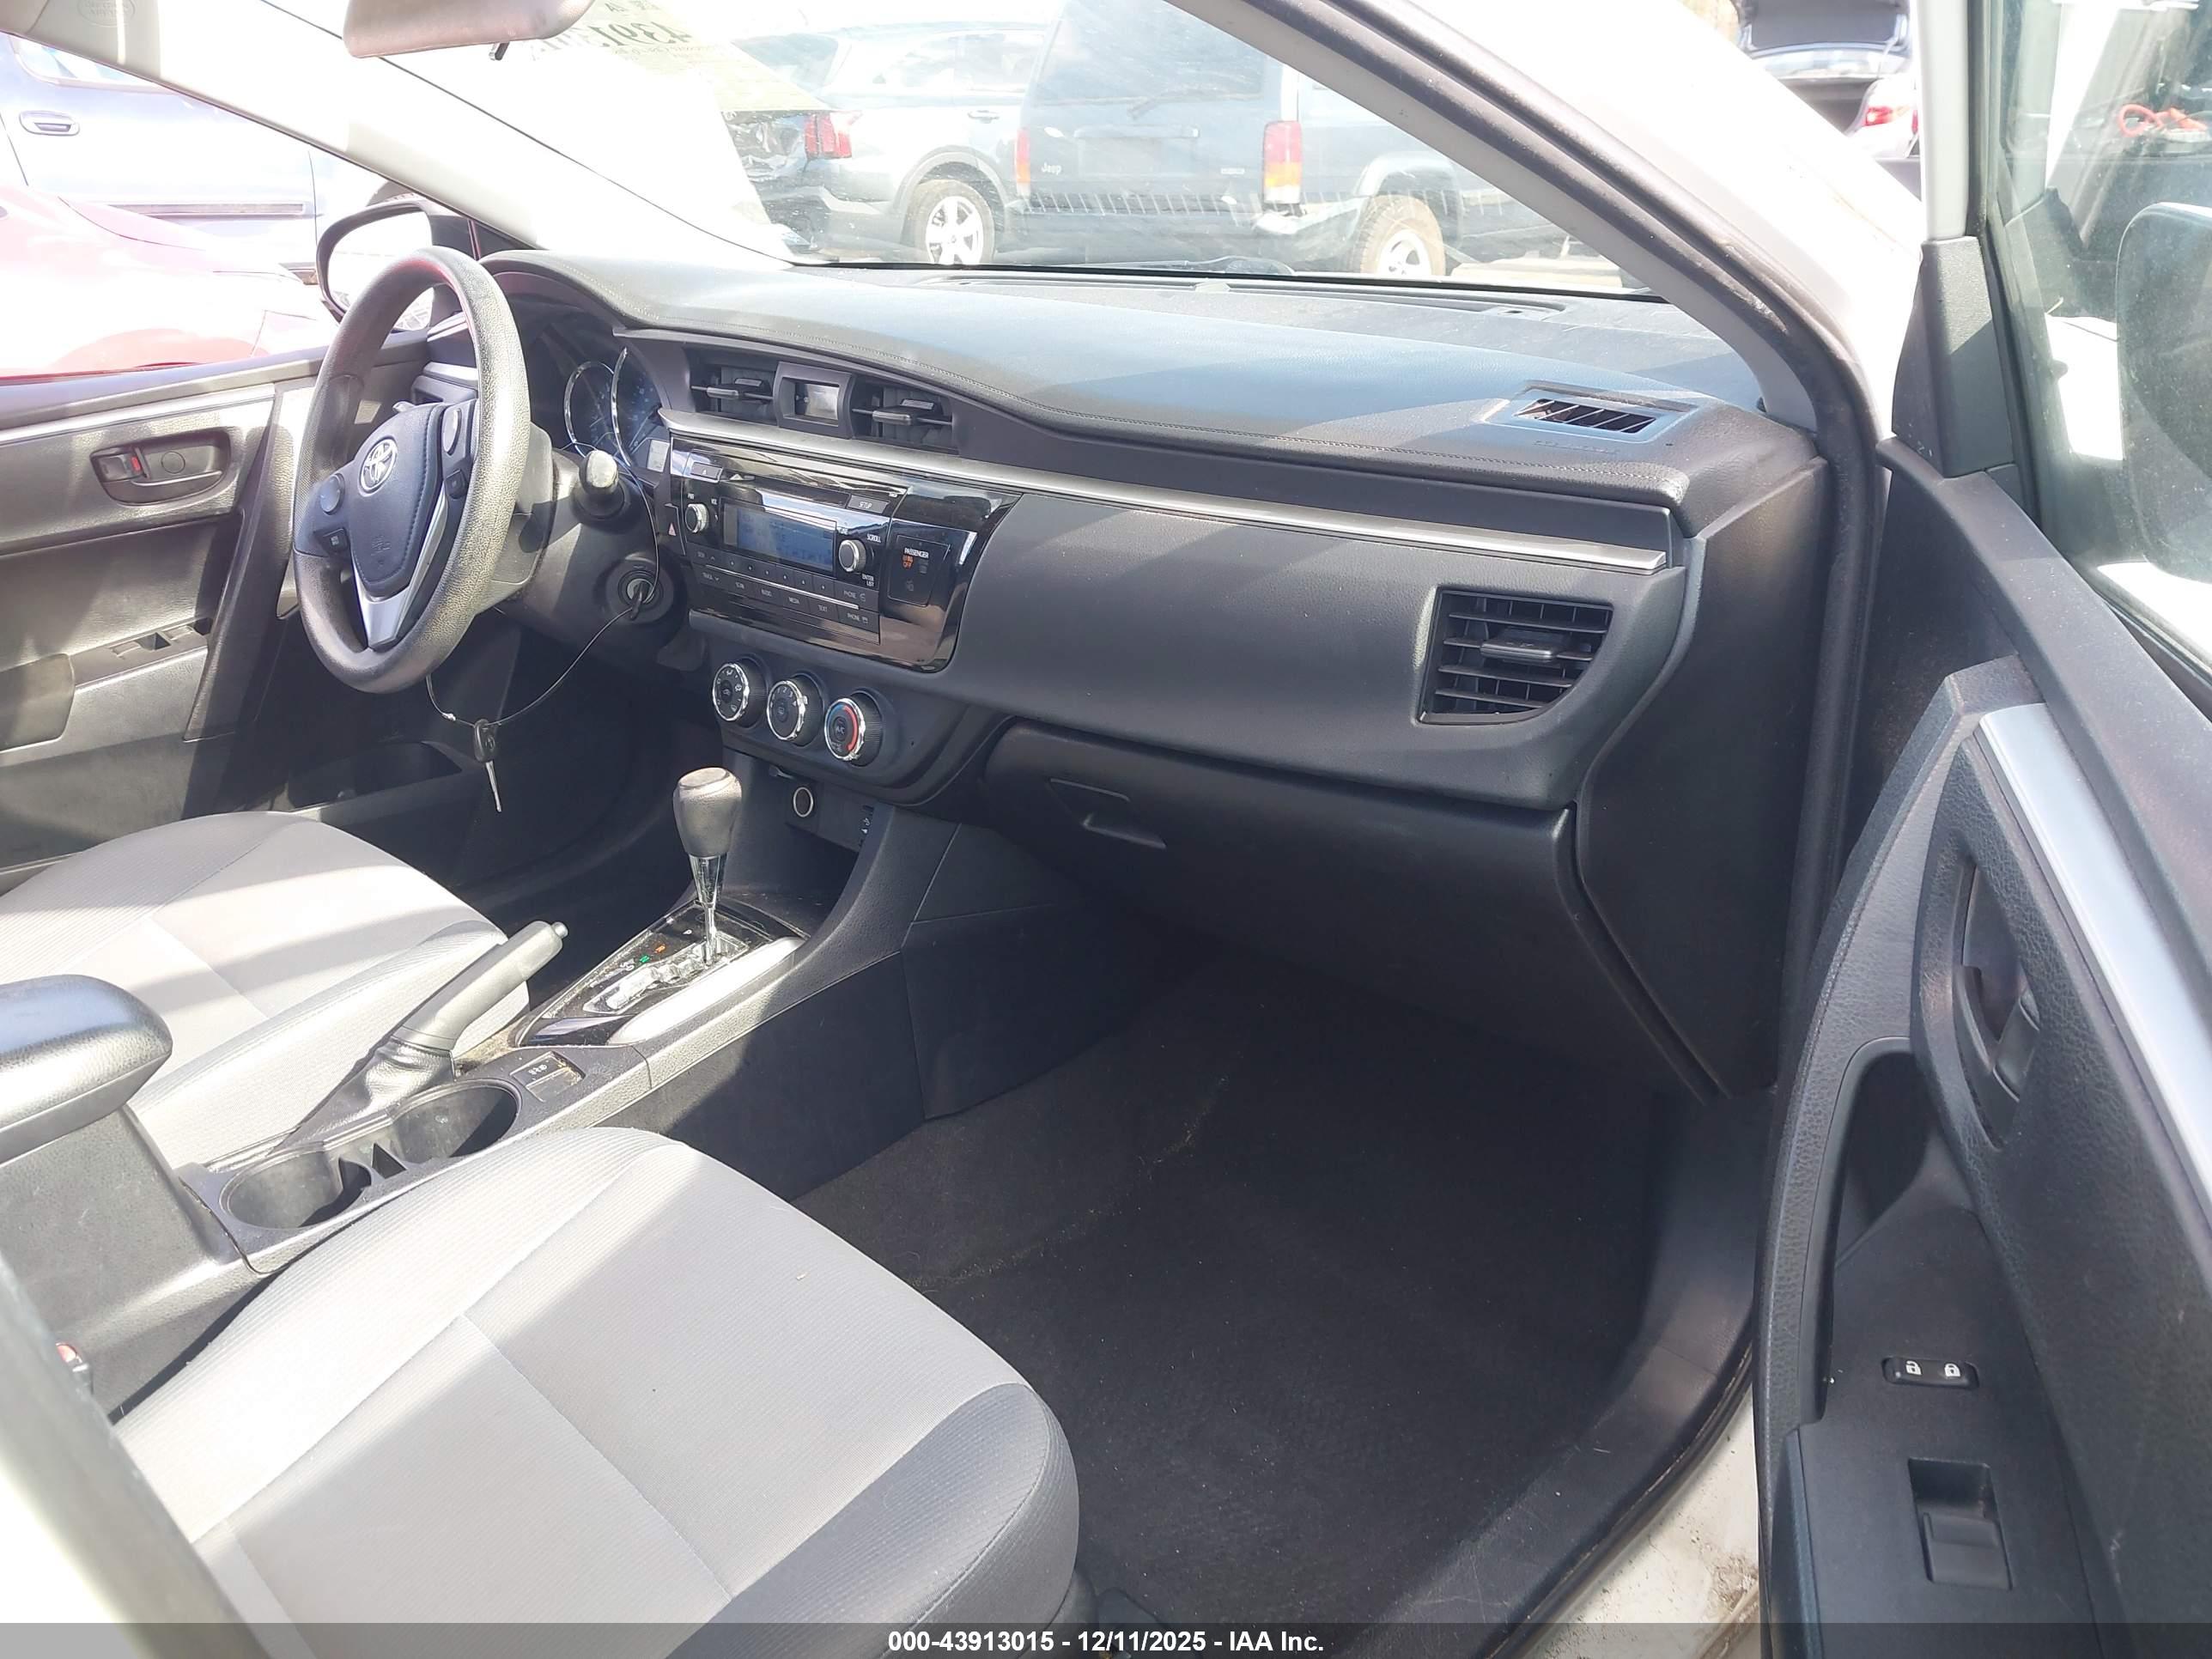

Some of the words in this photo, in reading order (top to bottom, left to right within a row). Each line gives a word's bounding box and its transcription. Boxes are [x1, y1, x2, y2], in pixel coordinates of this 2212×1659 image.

[1041, 162, 1062, 175] Jeep
[858, 501, 873, 510] SETUP
[866, 533, 882, 543] SCROLL
[903, 547, 929, 559] PASSENGER
